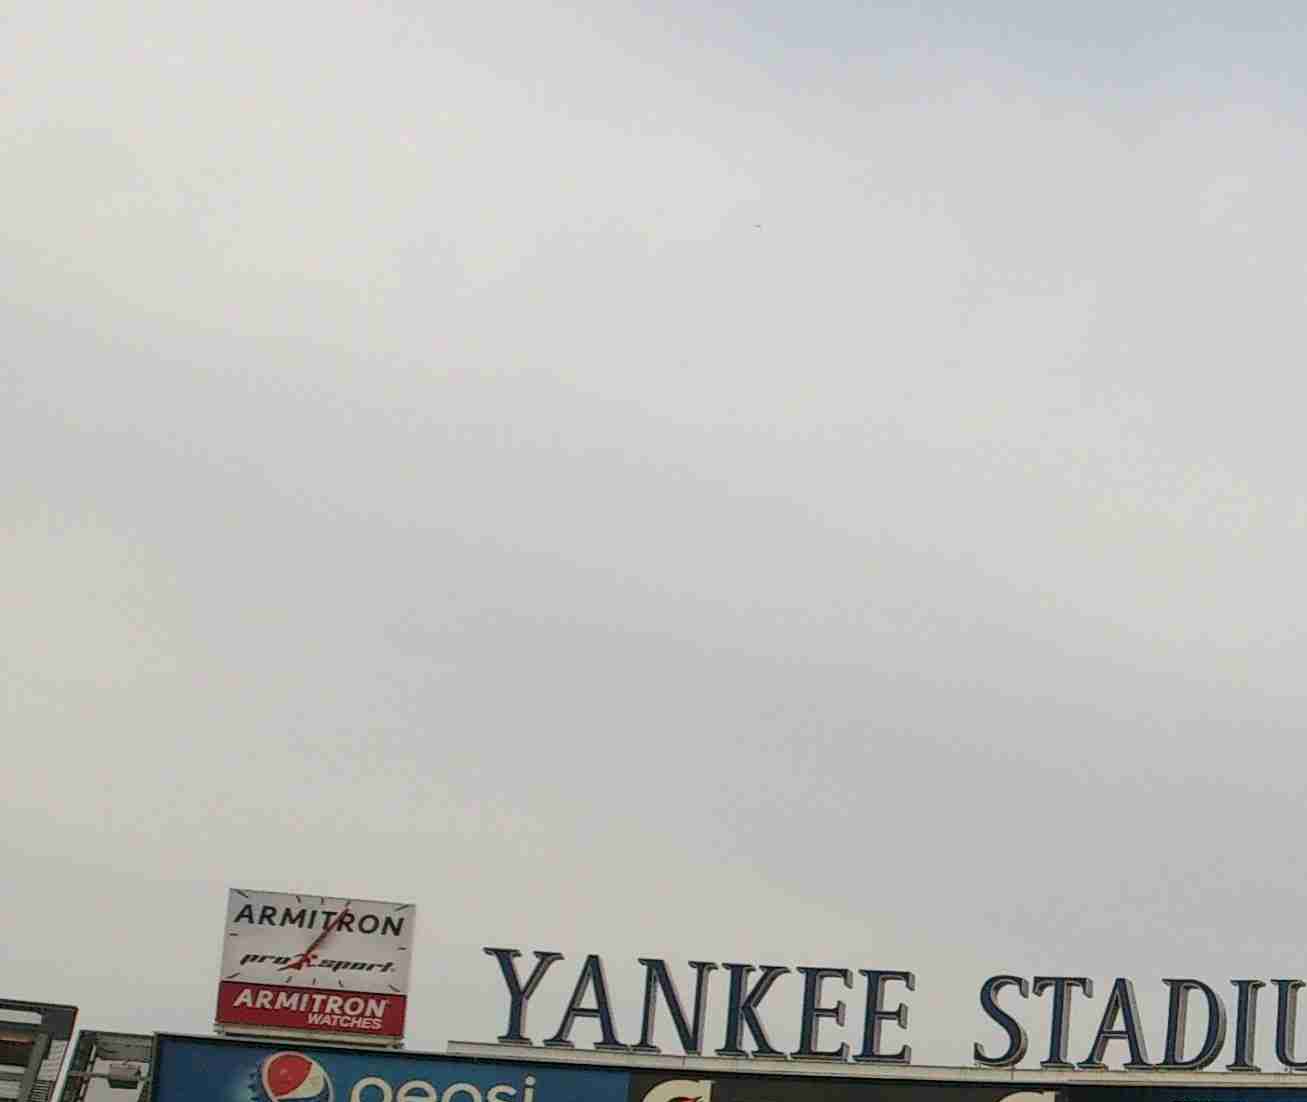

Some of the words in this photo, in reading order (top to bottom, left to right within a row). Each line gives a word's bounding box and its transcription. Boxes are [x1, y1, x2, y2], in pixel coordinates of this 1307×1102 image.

[233, 904, 404, 937] ARMITRON
[233, 988, 390, 1018] ARMITRON
[484, 947, 916, 1064] YANKEE
[308, 1013, 383, 1031] WATCHES
